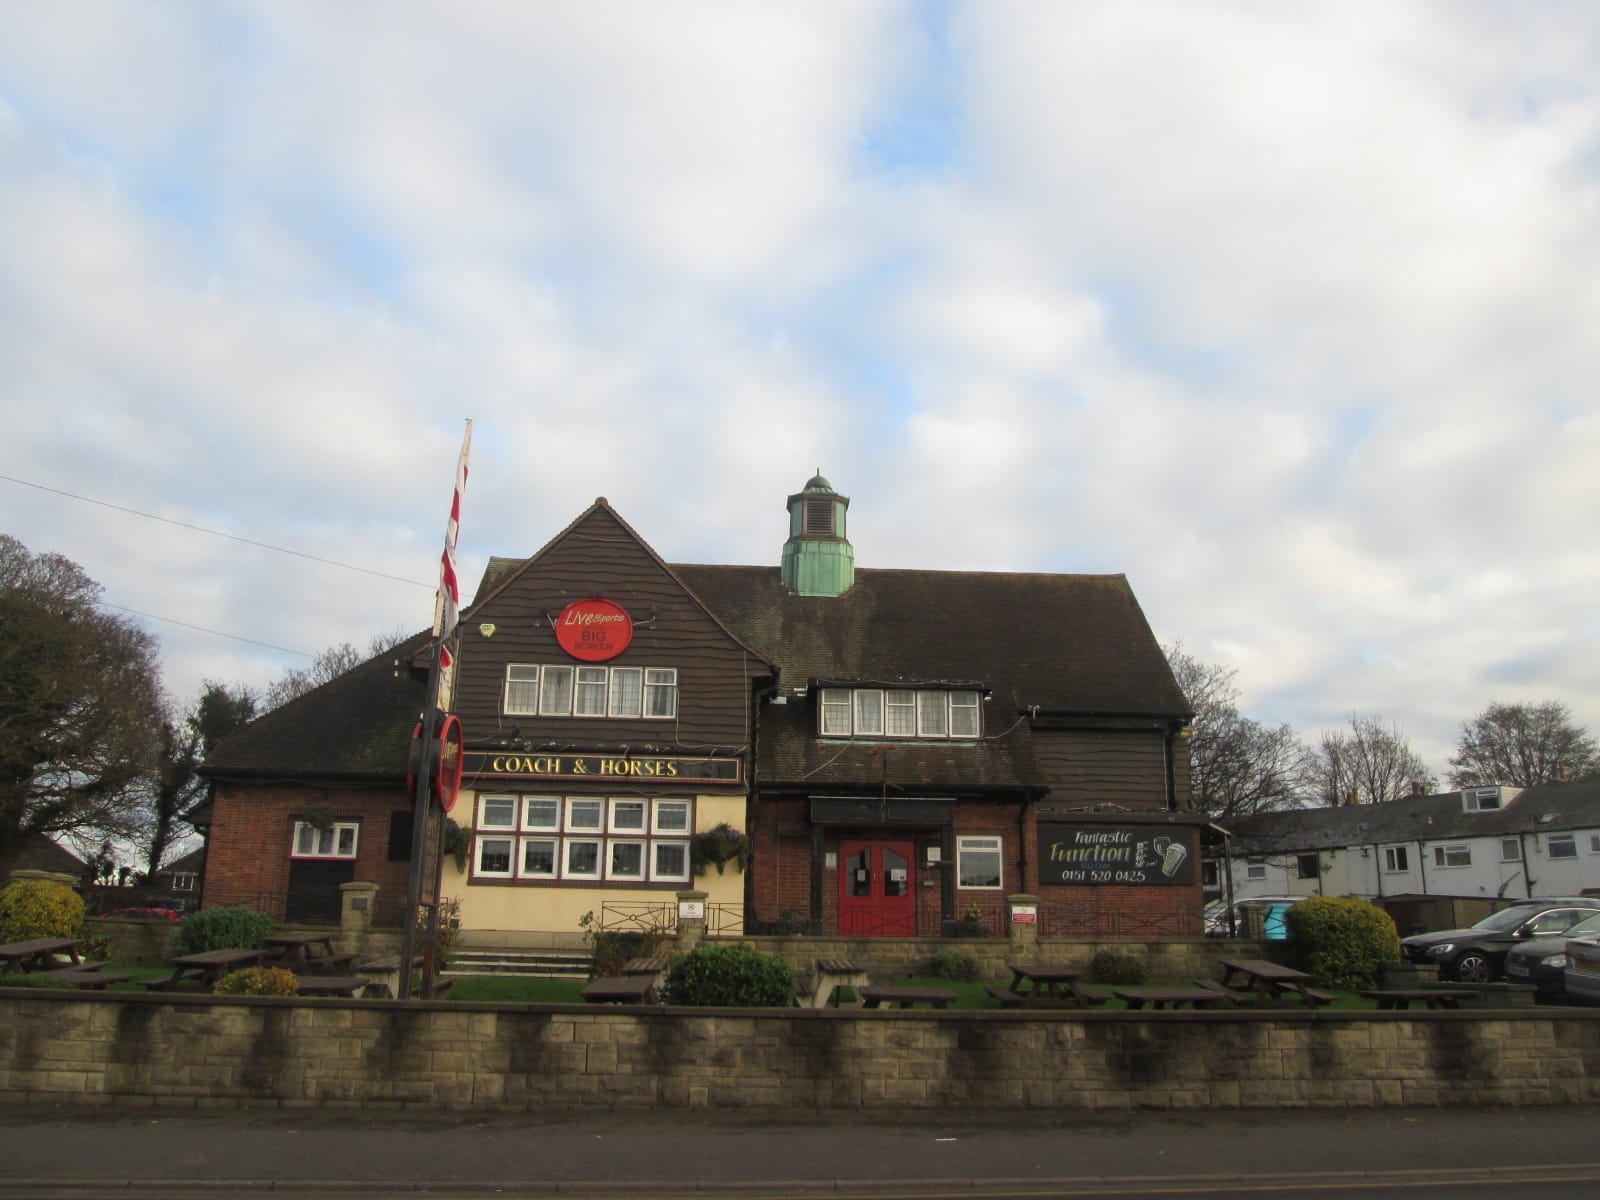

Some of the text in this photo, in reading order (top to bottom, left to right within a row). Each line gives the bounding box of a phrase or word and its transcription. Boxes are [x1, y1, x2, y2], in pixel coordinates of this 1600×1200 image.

[582, 631, 606, 641] BIG
[575, 642, 614, 650] SCREEN
[493, 756, 678, 776] COACH & HORSES
[1075, 831, 1133, 844] Fantastic
[1050, 842, 1131, 862] Function
[1062, 870, 1085, 881] 0151
[1091, 870, 1112, 881] 520
